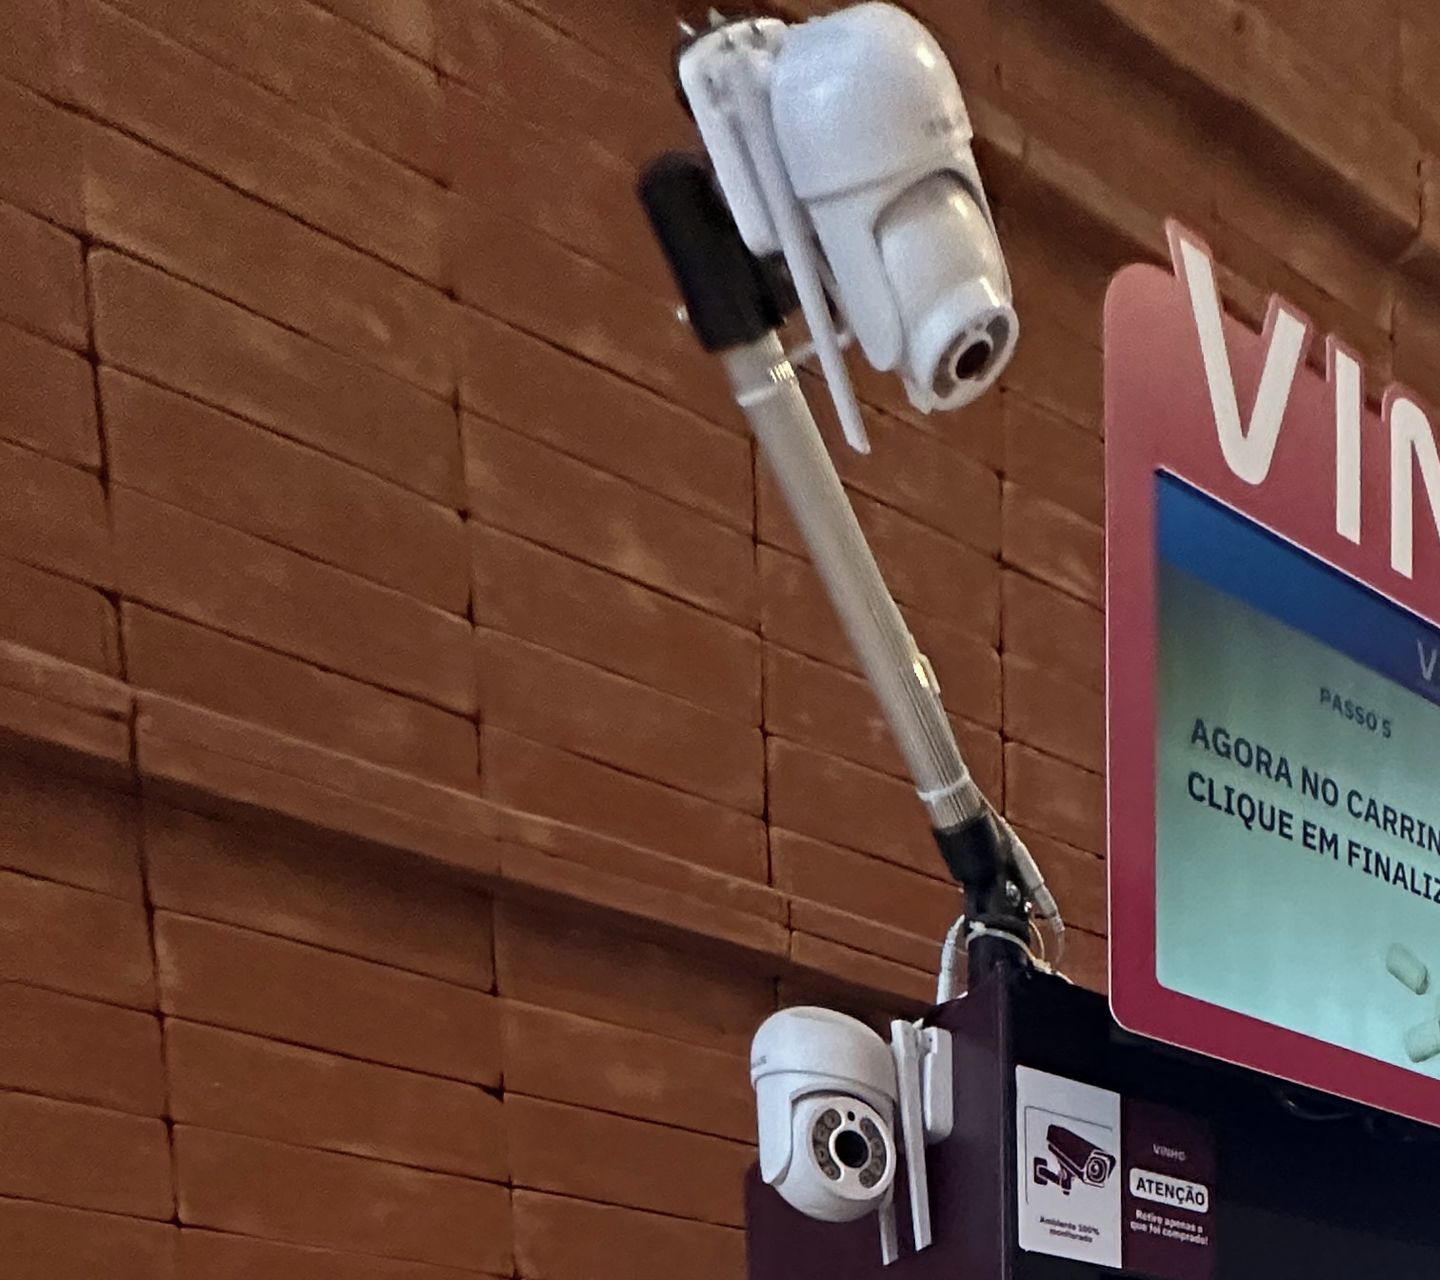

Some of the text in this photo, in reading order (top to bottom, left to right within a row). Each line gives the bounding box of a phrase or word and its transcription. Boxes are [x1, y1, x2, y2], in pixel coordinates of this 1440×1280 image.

[1320, 688, 1392, 738] PASSO 5
[1191, 716, 1292, 788] AGORA
[1301, 757, 1338, 807] NO
[1188, 772, 1293, 840] CLIQUE
[1302, 821, 1339, 861] EM
[1136, 1177, 1205, 1205] ATENÇÃO
[1130, 1221, 1147, 1231] que
[1135, 1209, 1163, 1225] Retire
